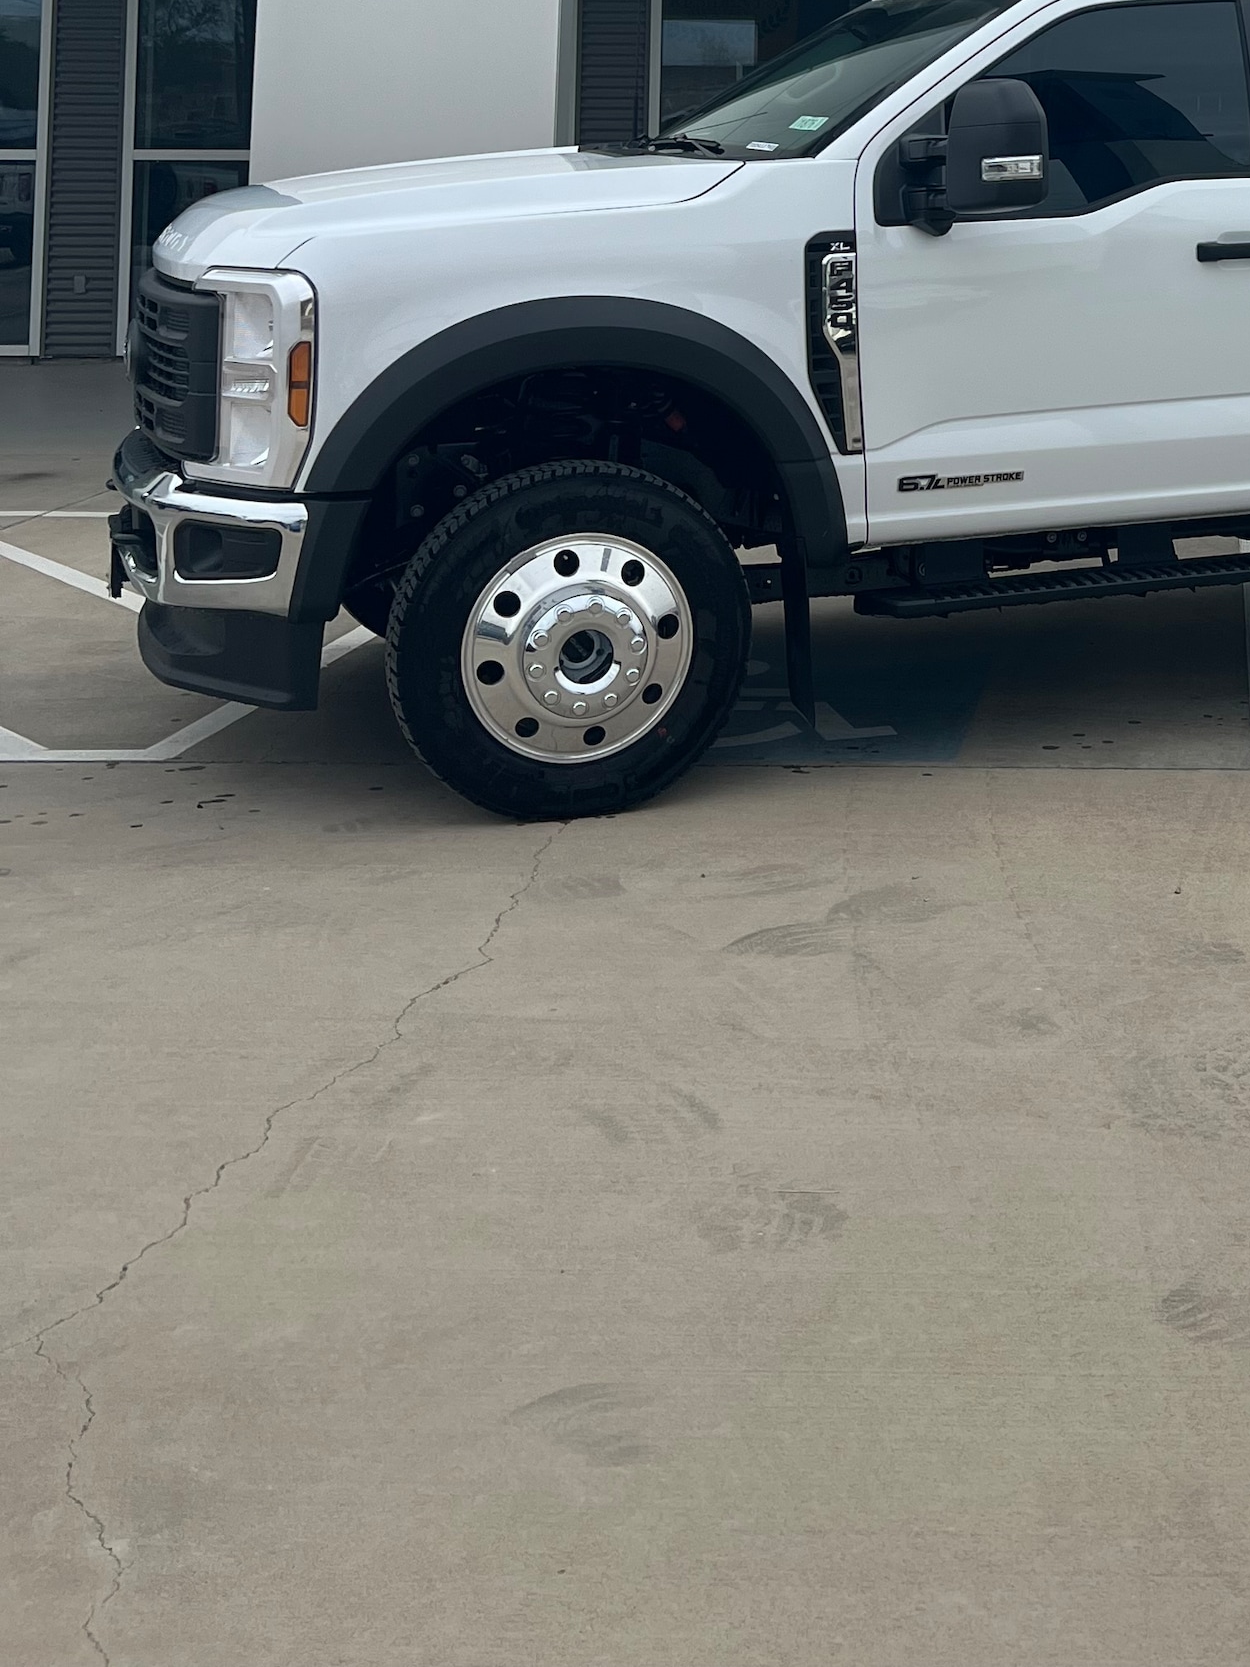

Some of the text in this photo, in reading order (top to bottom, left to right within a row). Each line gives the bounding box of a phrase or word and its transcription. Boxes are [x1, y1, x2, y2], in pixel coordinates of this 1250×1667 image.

[830, 242, 851, 251] XL
[898, 474, 945, 492] 6.7L
[947, 475, 981, 485] POWER
[983, 471, 1023, 483] STROKE
